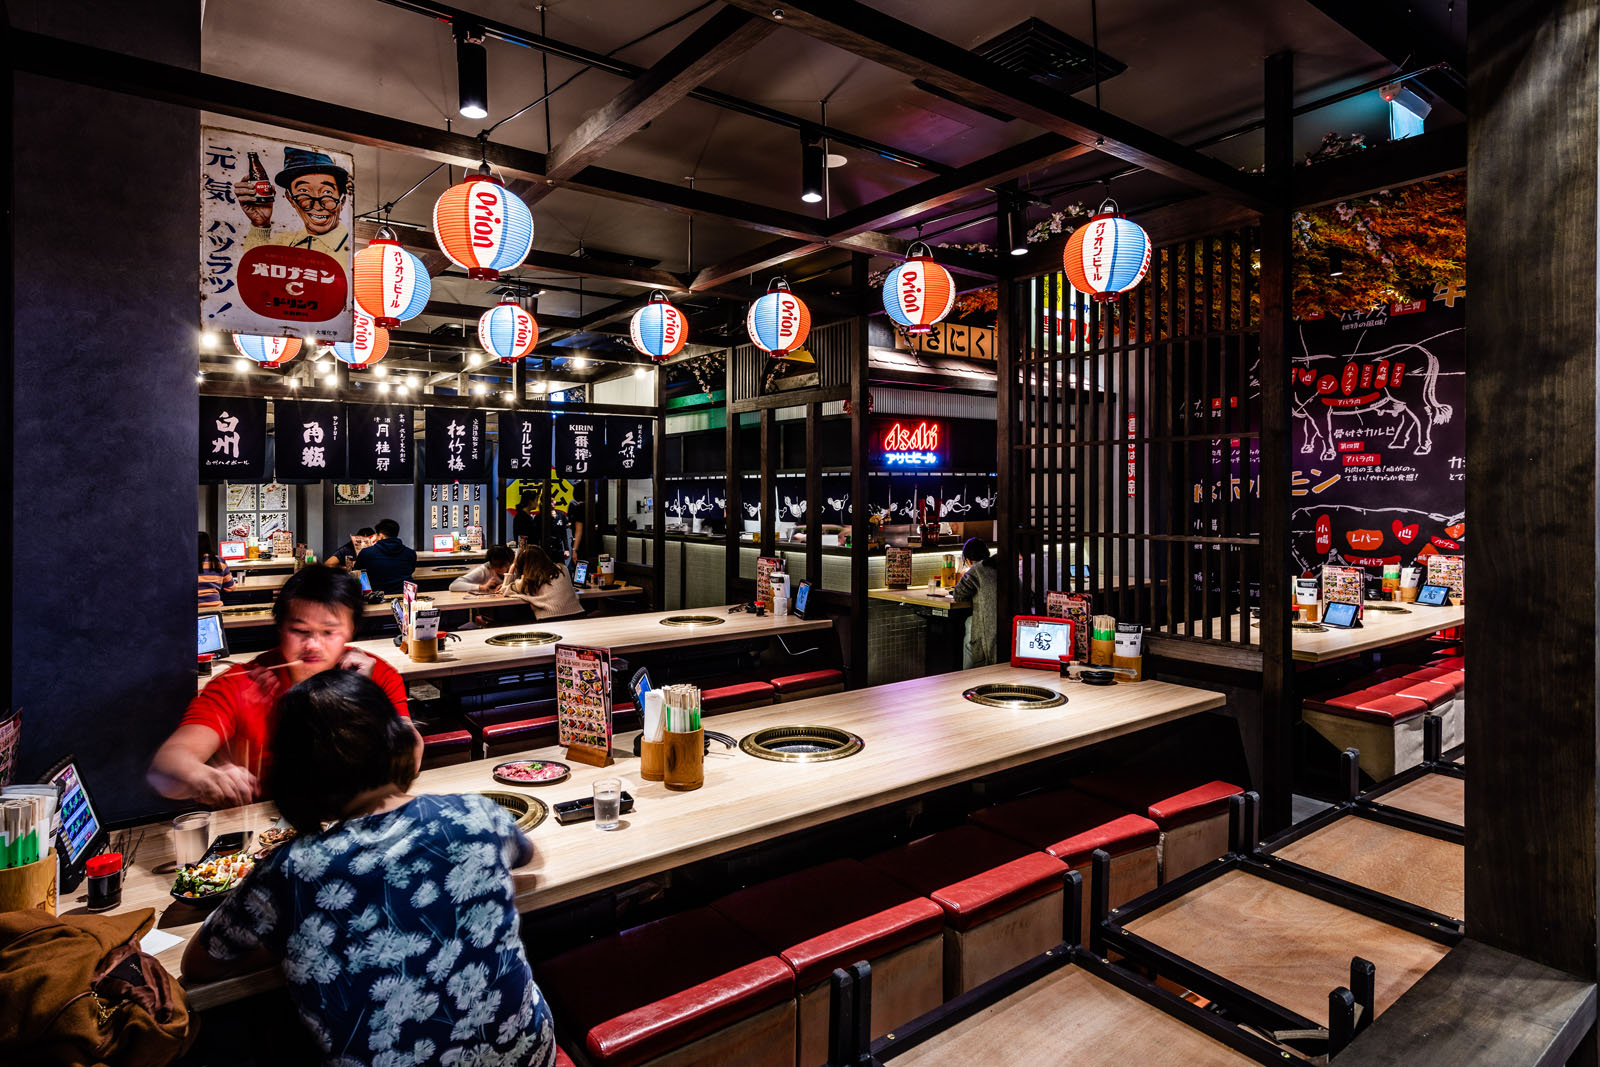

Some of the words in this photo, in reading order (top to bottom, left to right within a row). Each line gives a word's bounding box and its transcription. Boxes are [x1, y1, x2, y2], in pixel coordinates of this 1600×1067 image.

[473, 191, 502, 249] Orion
[1093, 222, 1106, 281] オリオンビール
[252, 262, 335, 284] オロナミン
[285, 281, 304, 296] C
[902, 271, 921, 313] Orion
[355, 317, 372, 350] Orion
[515, 315, 532, 348] Orion
[664, 309, 680, 343] Orion
[780, 300, 798, 337] Orion
[898, 325, 986, 357] きにく
[1321, 381, 1335, 390] ミノ
[1345, 366, 1354, 391] ハチノス
[375, 424, 391, 471] 月桂冠
[447, 419, 466, 472] 松竹梅
[521, 421, 532, 468] カルピス
[884, 422, 938, 451] Asahi
[1333, 426, 1395, 439] 骨付きカルビ
[618, 431, 635, 468] 久保田
[885, 451, 937, 465] アサヒビール
[1352, 533, 1380, 543] レバー
[1398, 528, 1412, 539] 心
